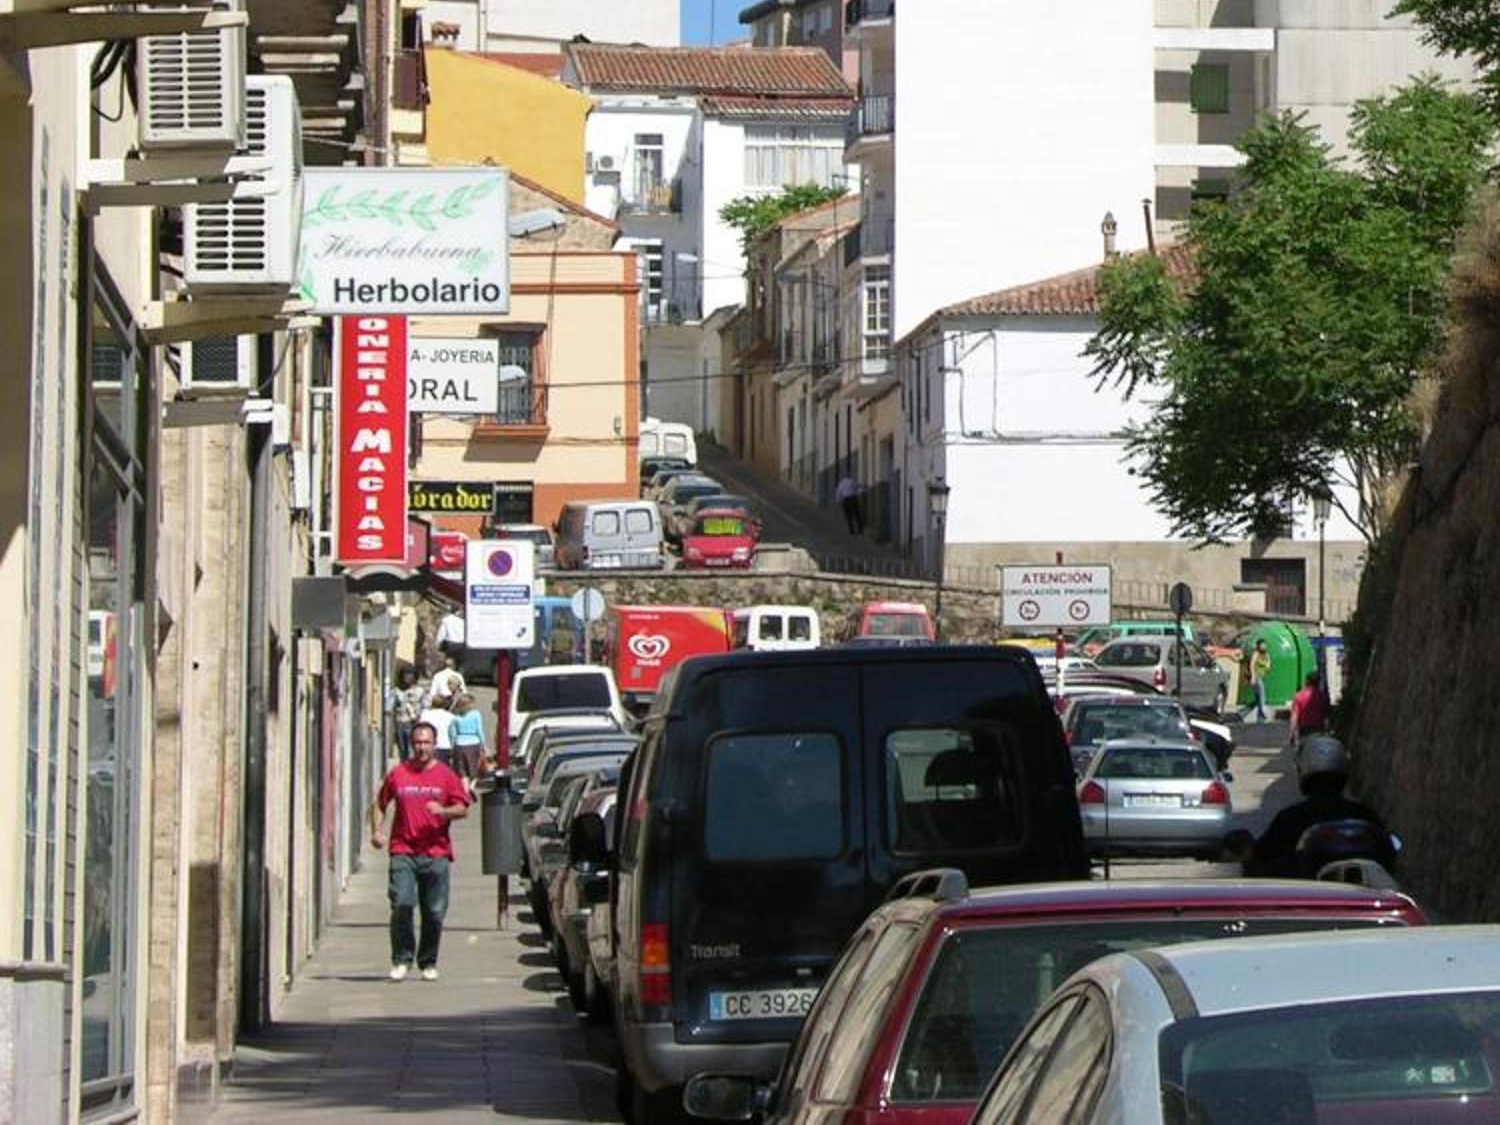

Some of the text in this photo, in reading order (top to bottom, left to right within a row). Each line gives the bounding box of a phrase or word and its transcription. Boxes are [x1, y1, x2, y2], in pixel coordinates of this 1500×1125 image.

[334, 277, 501, 304] Herbolario
[430, 348, 495, 364] JOYERIA
[350, 427, 392, 551] MACIAS
[725, 992, 814, 1016] CC 3926
